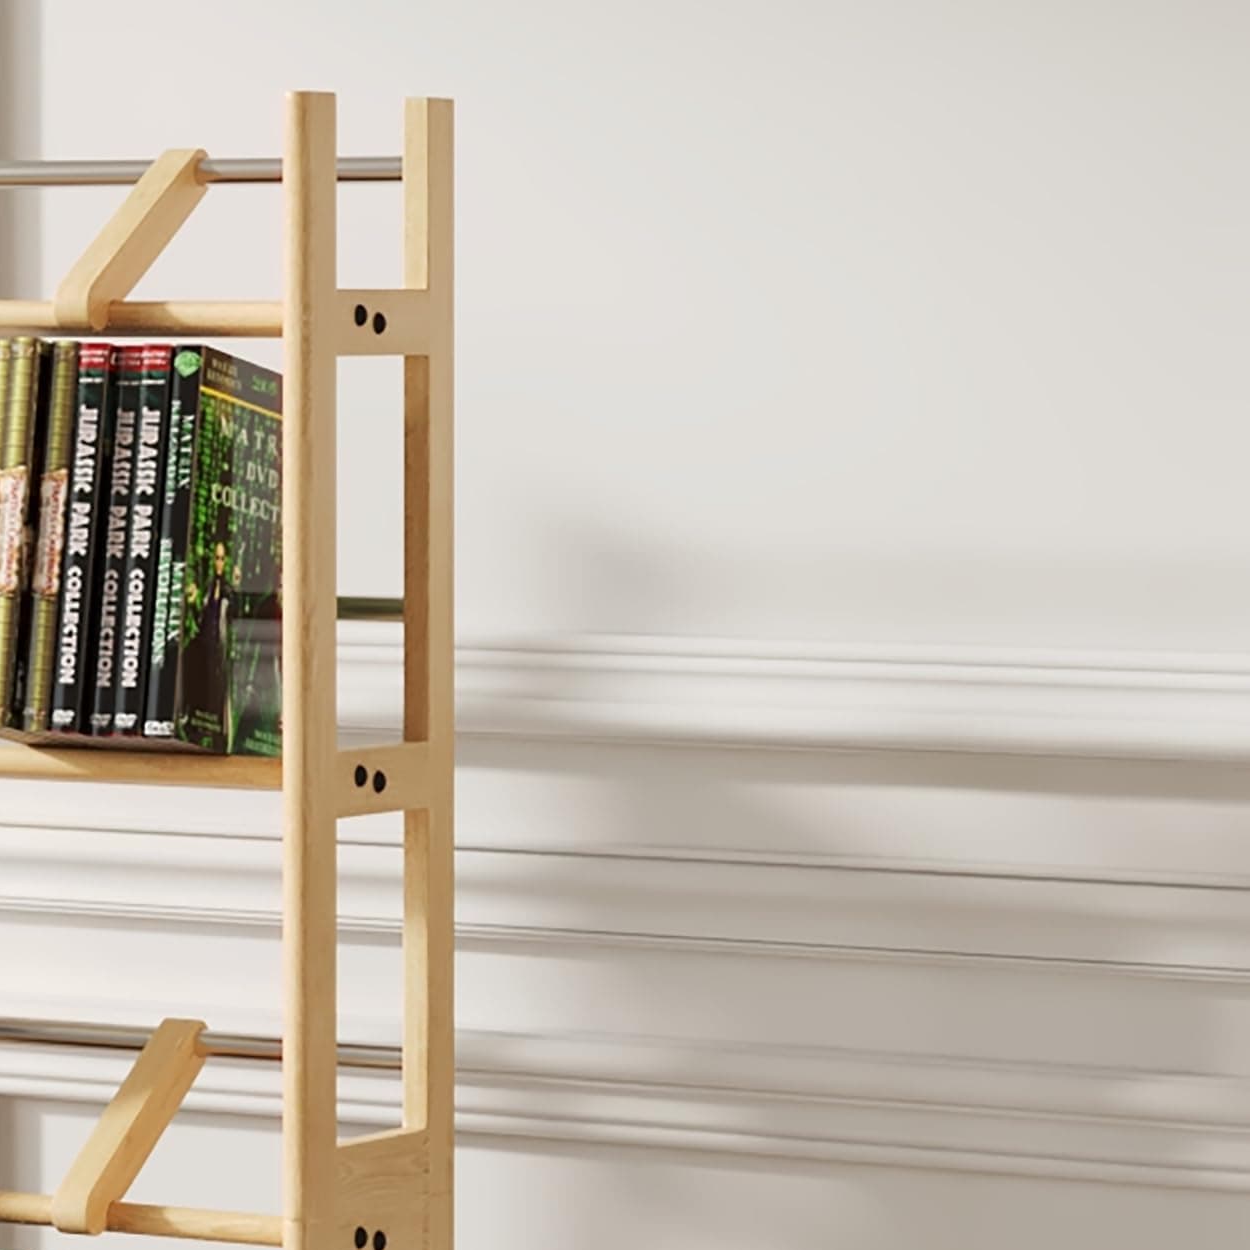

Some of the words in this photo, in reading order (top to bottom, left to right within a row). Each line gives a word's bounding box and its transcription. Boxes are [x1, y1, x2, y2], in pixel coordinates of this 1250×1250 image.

[73, 403, 98, 494] JURASSIC
[111, 407, 135, 496] JURASSIC
[135, 405, 161, 496] JURASSIC
[177, 415, 195, 489] MATRIX
[246, 460, 280, 488] DVD
[68, 501, 91, 557] PARK
[106, 505, 127, 559] PARK
[130, 504, 153, 559] PARK
[58, 565, 83, 684] COLLECTION
[96, 568, 118, 687] COLLECTION
[121, 568, 144, 688] COLLECTION
[151, 538, 175, 667] REVOLUTIONS
[167, 562, 186, 641] MATRIX
